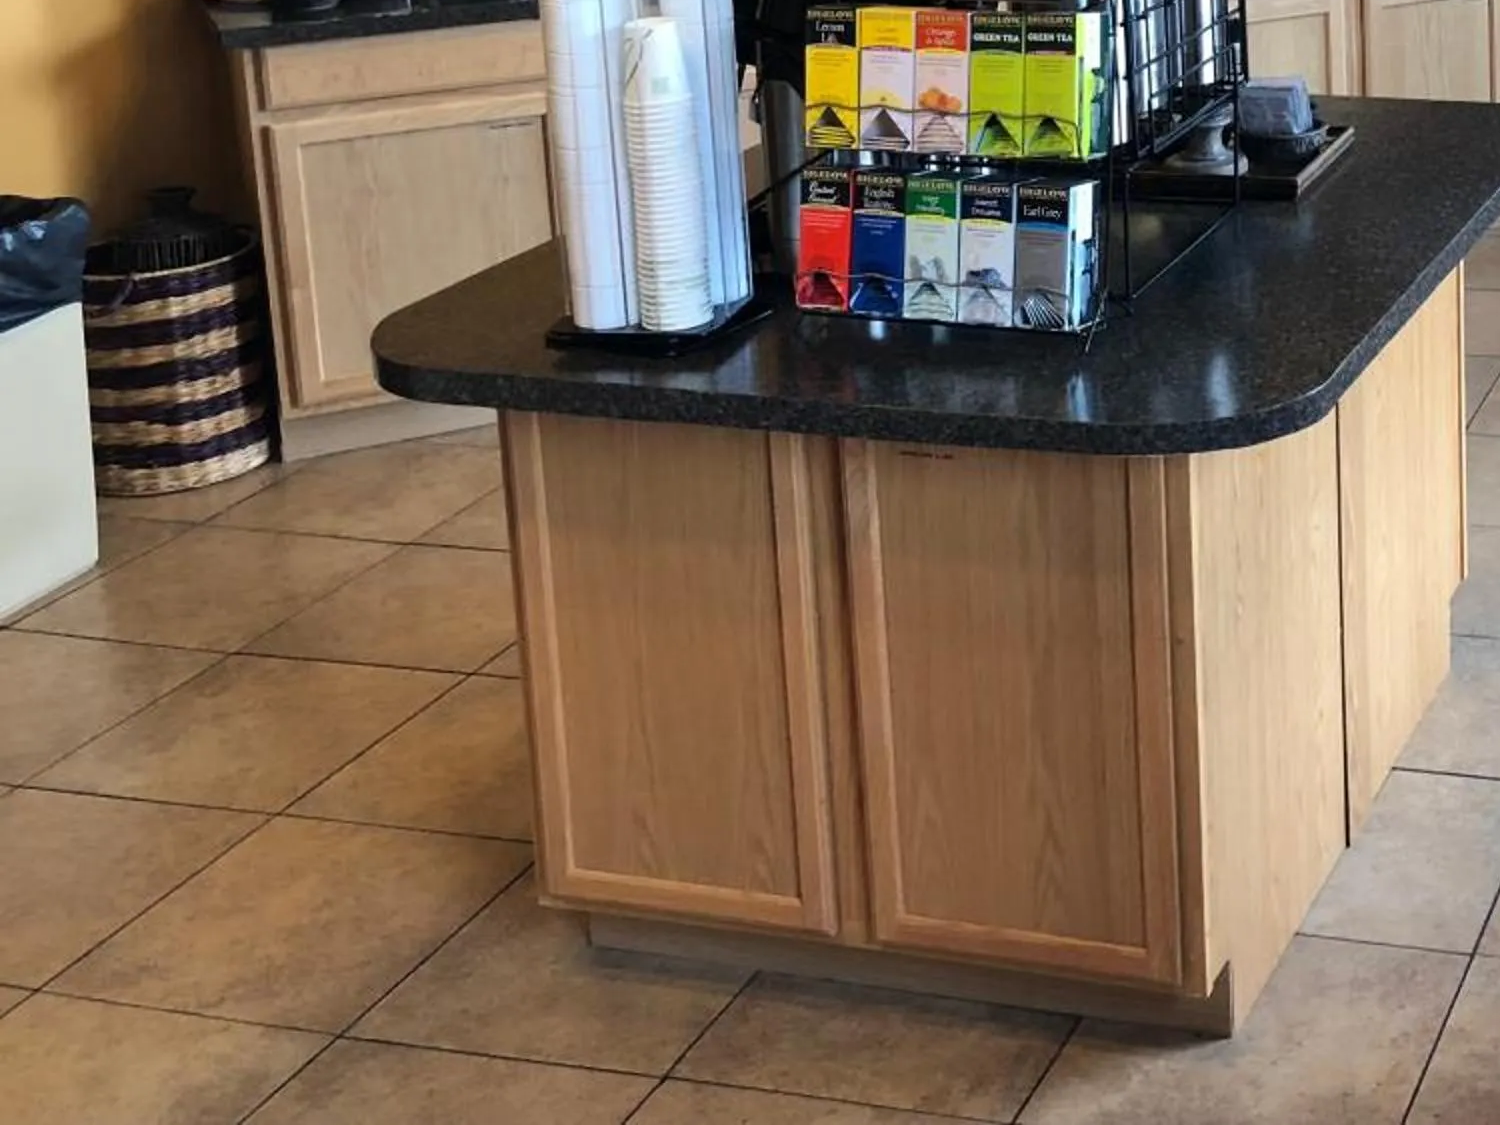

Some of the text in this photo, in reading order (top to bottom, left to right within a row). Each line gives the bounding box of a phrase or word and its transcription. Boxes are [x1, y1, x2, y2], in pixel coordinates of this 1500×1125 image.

[973, 32, 1020, 43] GREEN TEA
[1027, 32, 1073, 43] GREEN TEA
[1023, 204, 1041, 217] Earl
